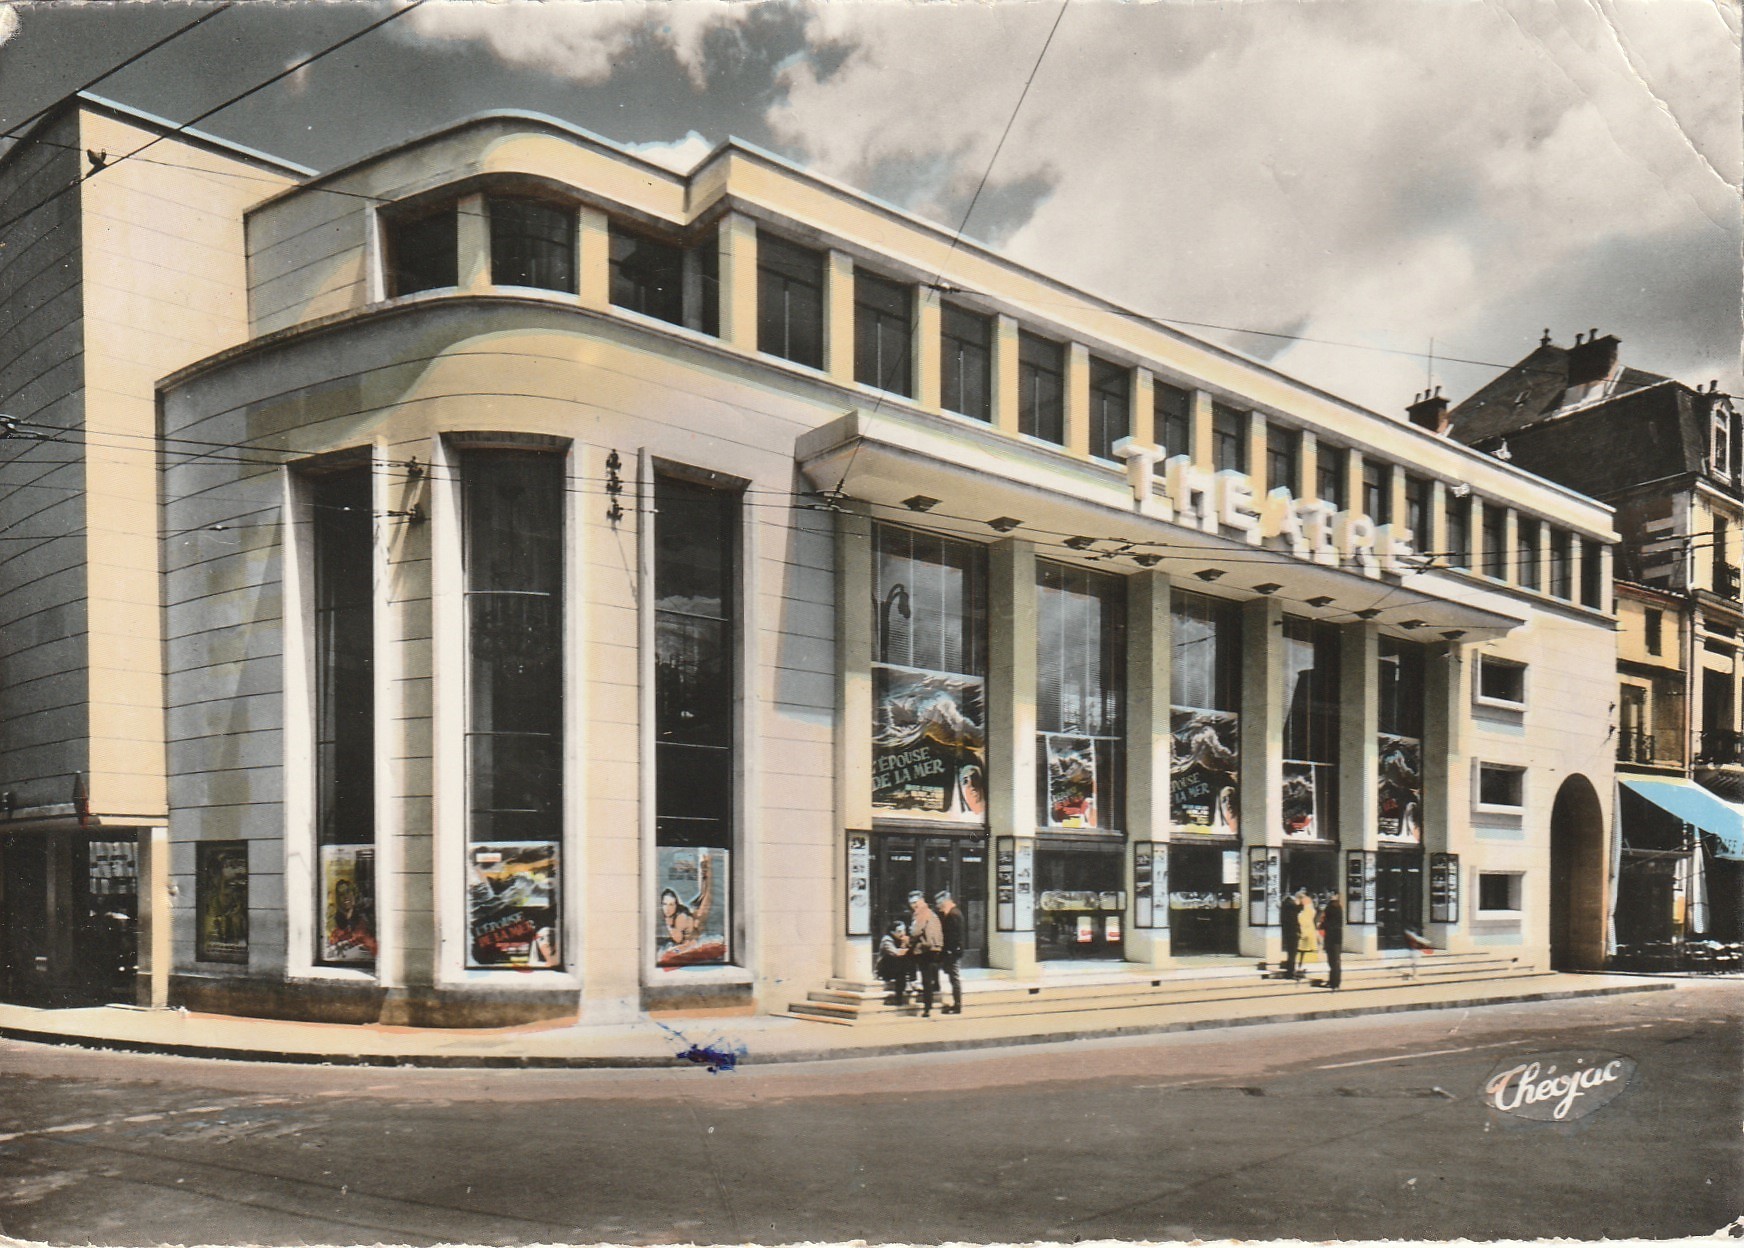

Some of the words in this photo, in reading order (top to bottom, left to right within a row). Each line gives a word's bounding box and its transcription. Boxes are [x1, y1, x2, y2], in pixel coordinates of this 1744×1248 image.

[1112, 436, 1416, 576] THEATRE
[895, 768, 911, 784] LA
[914, 759, 945, 779] MER
